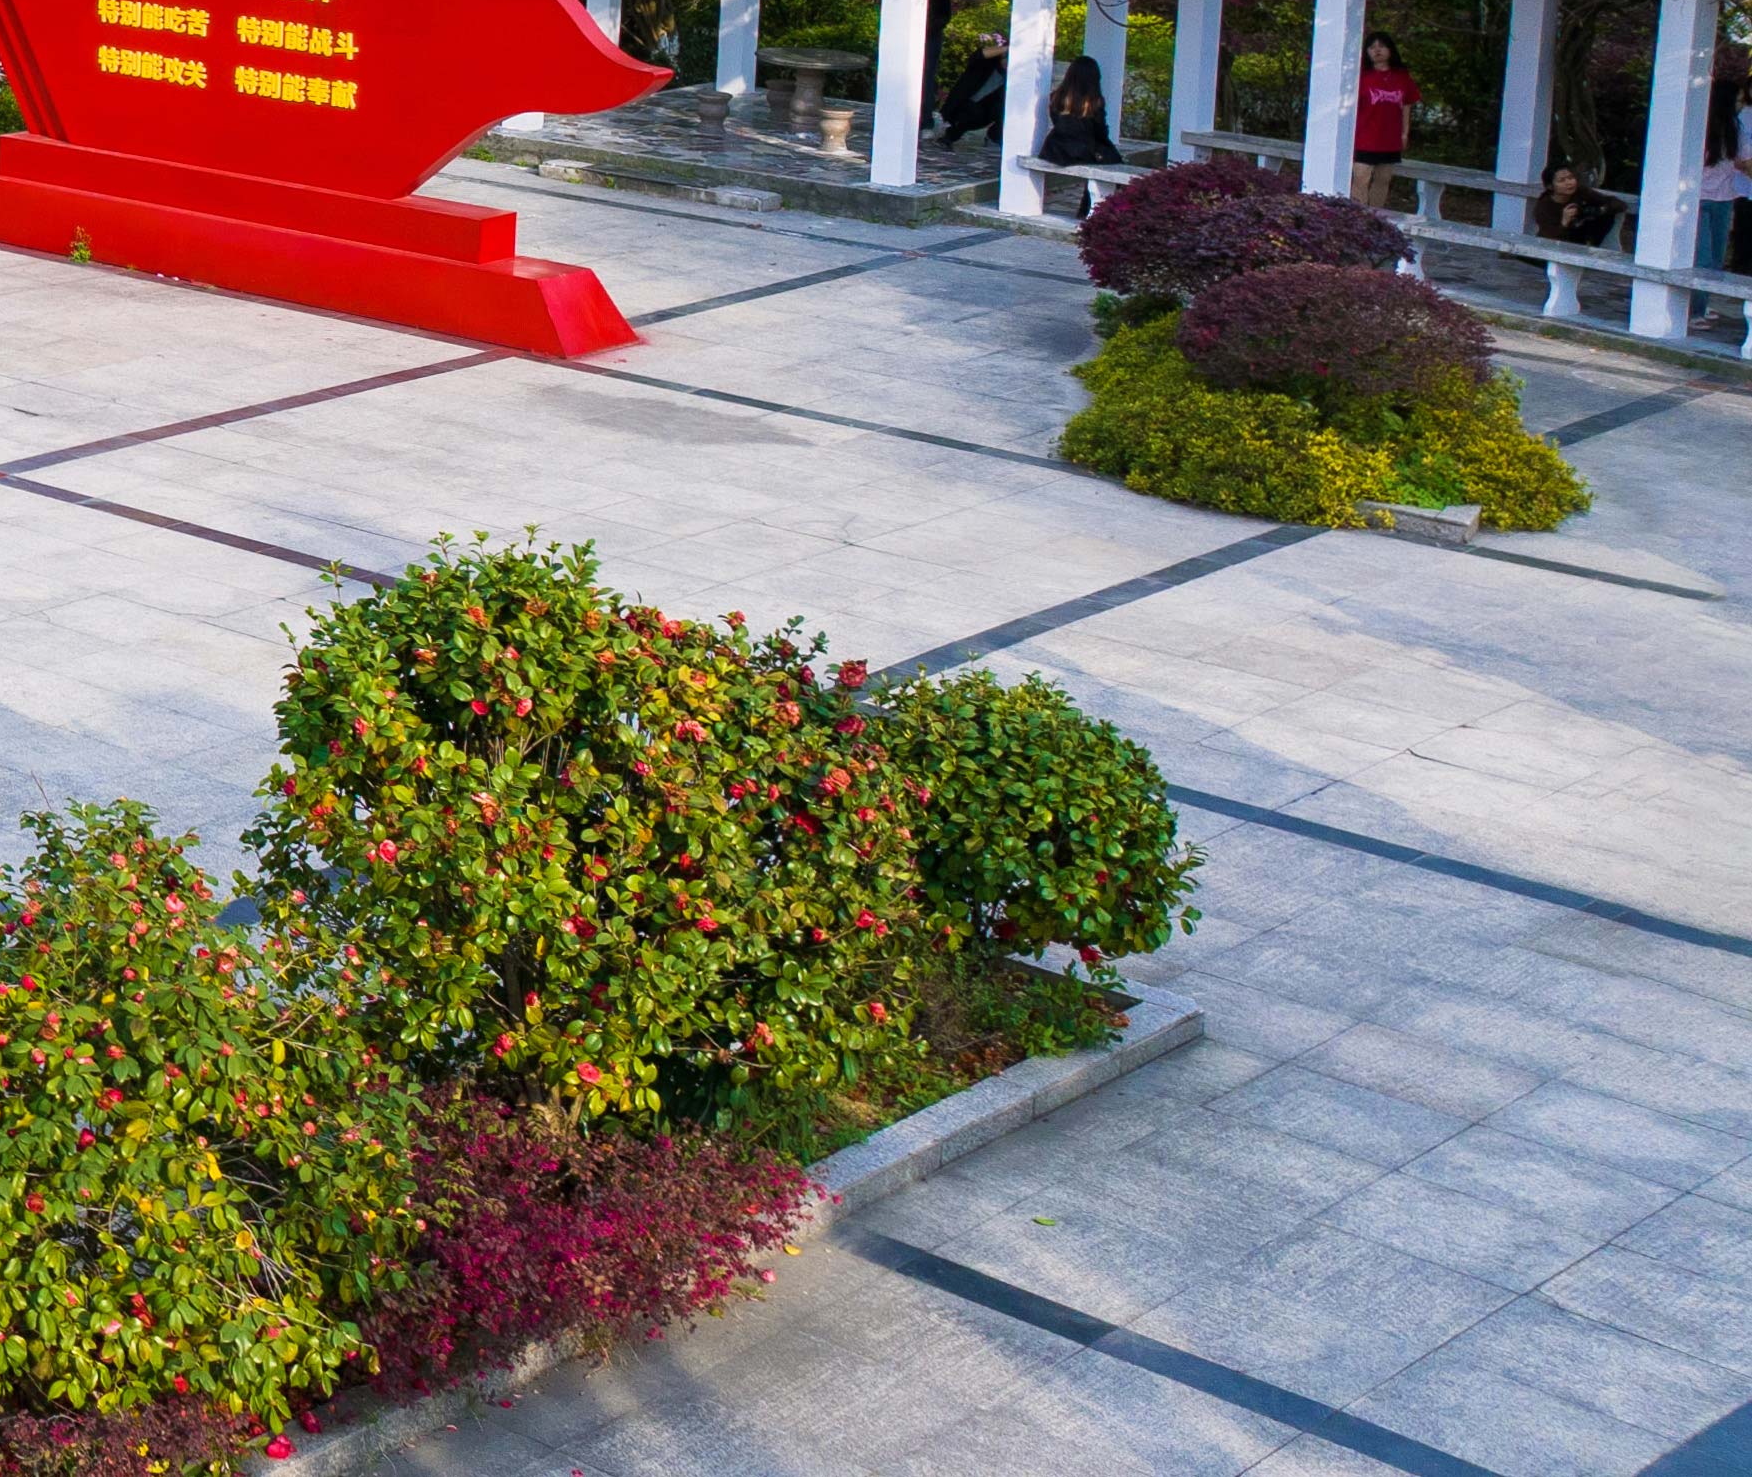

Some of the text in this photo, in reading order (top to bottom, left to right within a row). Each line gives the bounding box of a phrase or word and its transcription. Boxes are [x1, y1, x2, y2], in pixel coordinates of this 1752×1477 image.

[236, 16, 359, 60] 特别能战斗
[97, 45, 358, 109] 特别能攻关 特别能奉献
